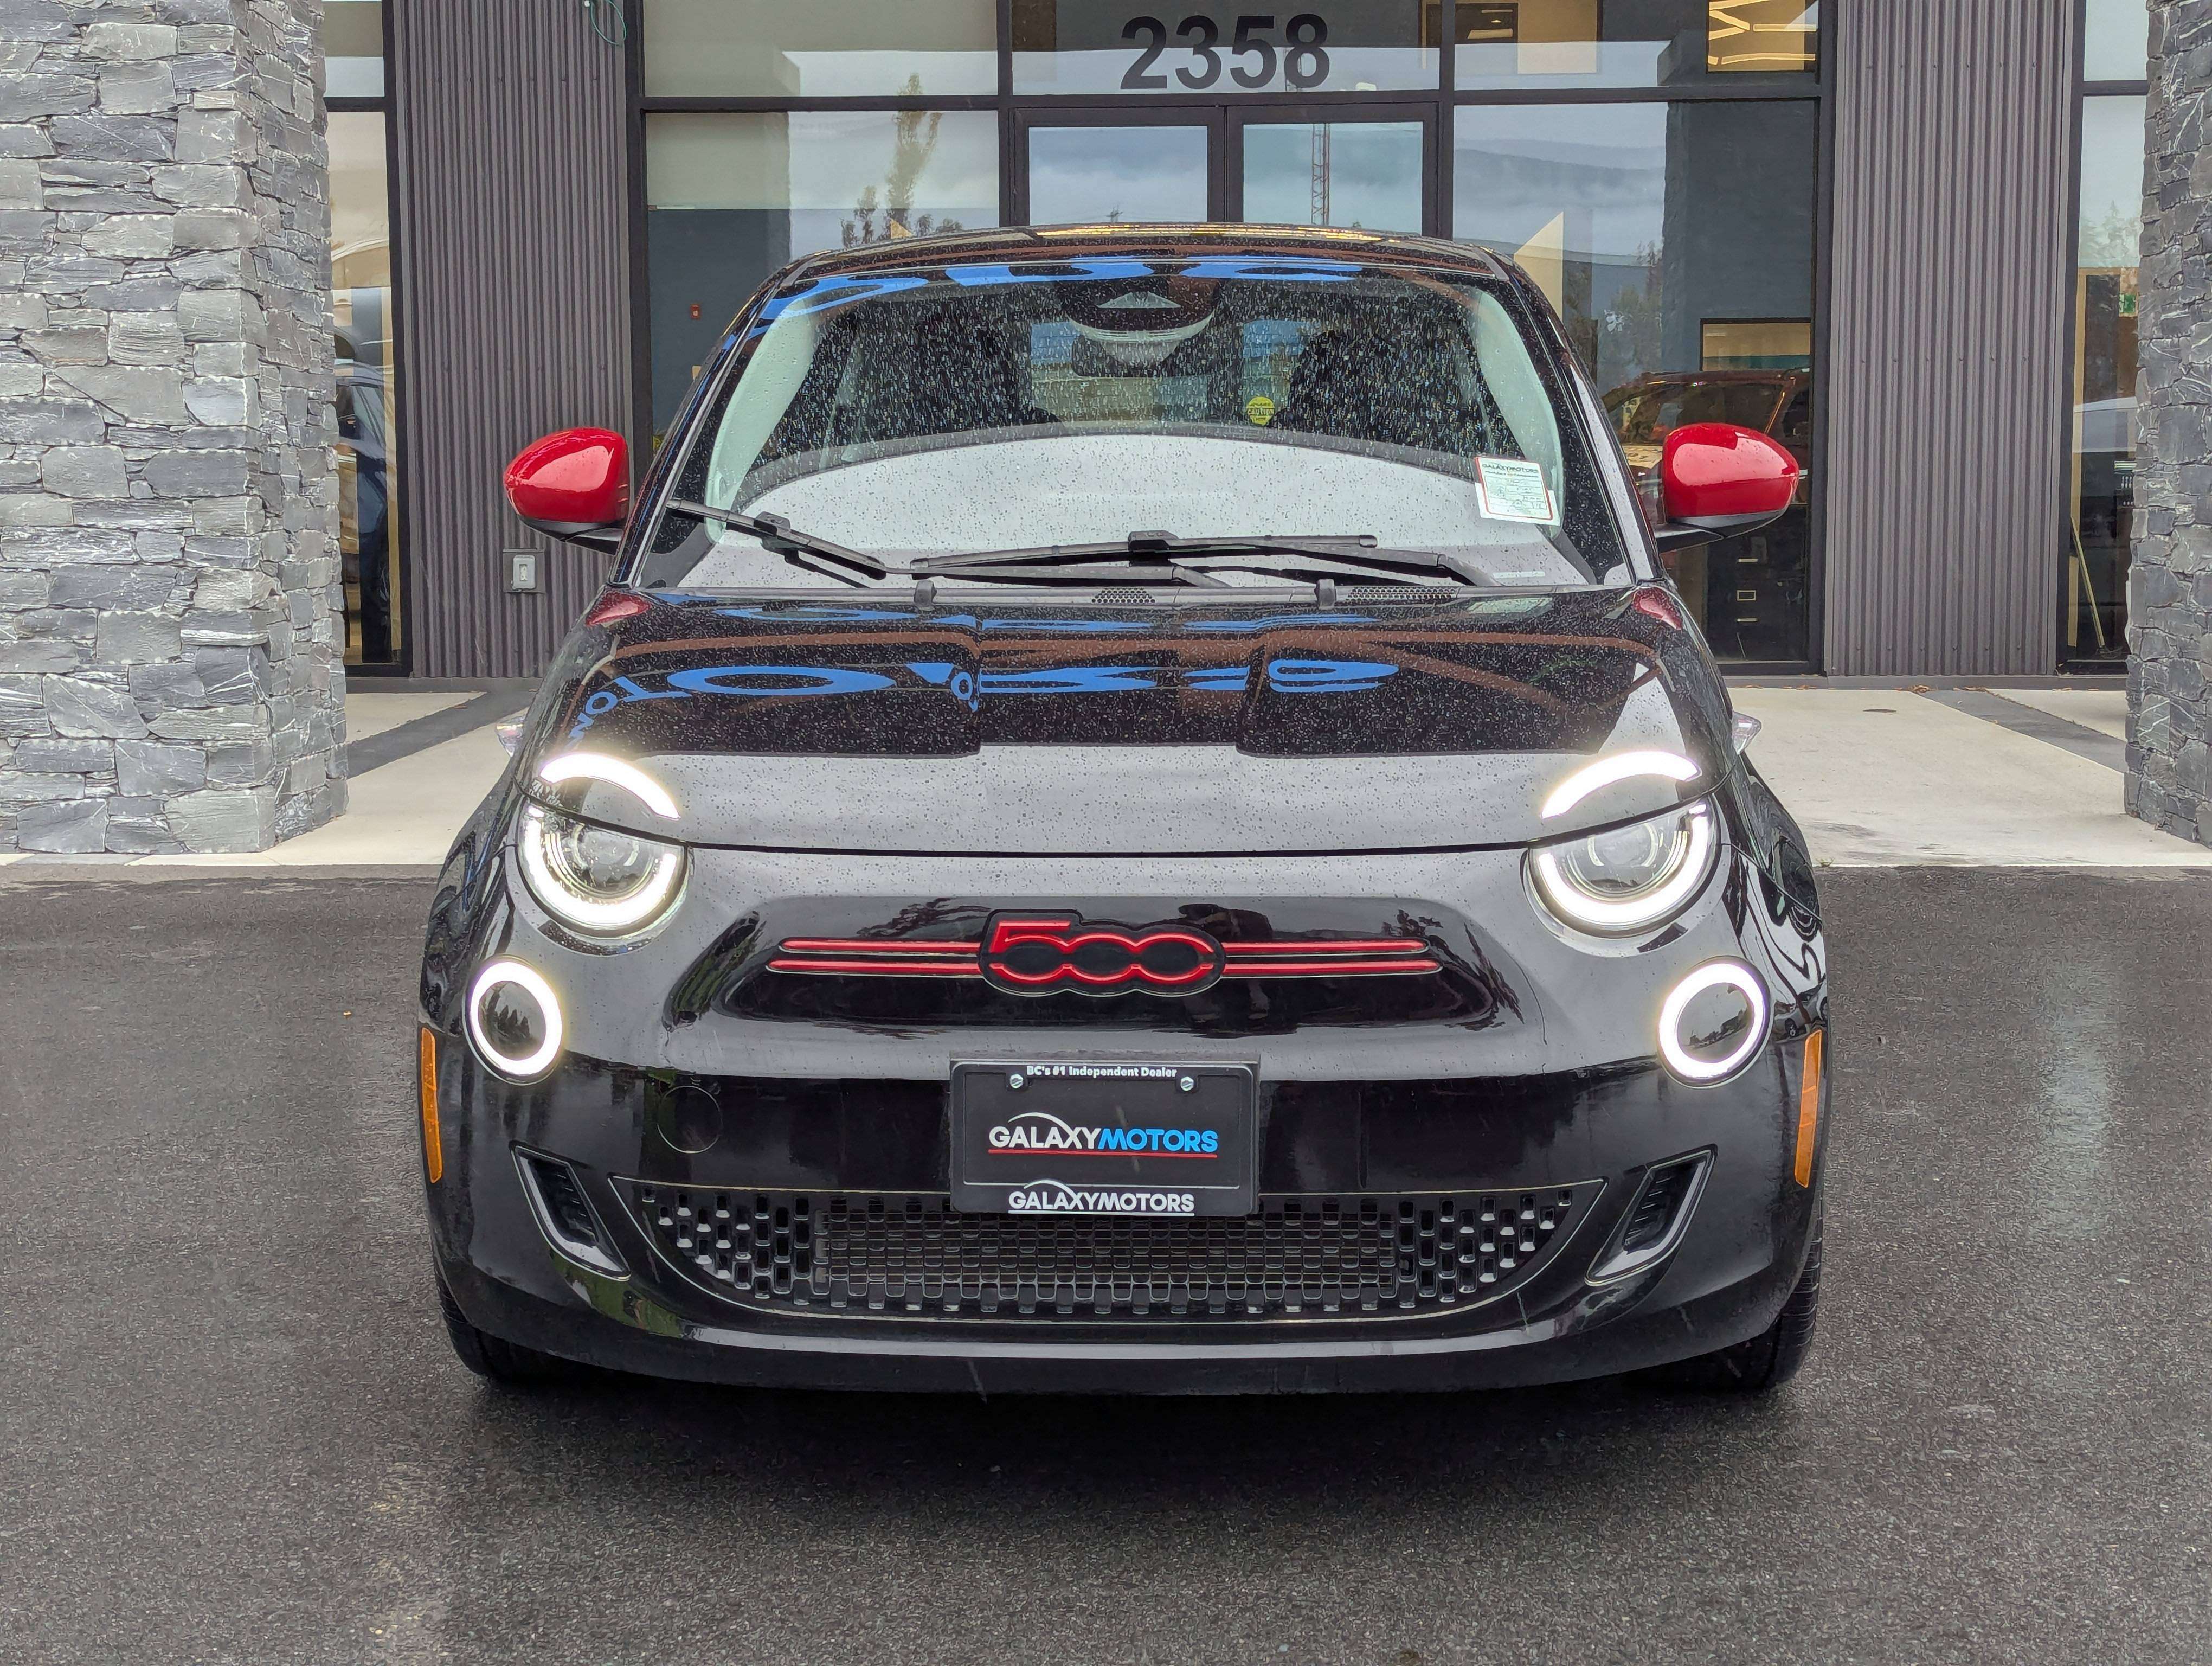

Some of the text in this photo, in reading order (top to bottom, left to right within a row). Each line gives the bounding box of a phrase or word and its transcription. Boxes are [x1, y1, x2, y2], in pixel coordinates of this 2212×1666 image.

[1120, 14, 1330, 89] 2358
[988, 920, 1215, 984] 500
[1026, 1066, 1051, 1075] BC's
[1069, 1066, 1139, 1078] Independent
[1141, 1067, 1177, 1077] Dealer
[1008, 1190, 1194, 1212] GALAXYMOTORS
